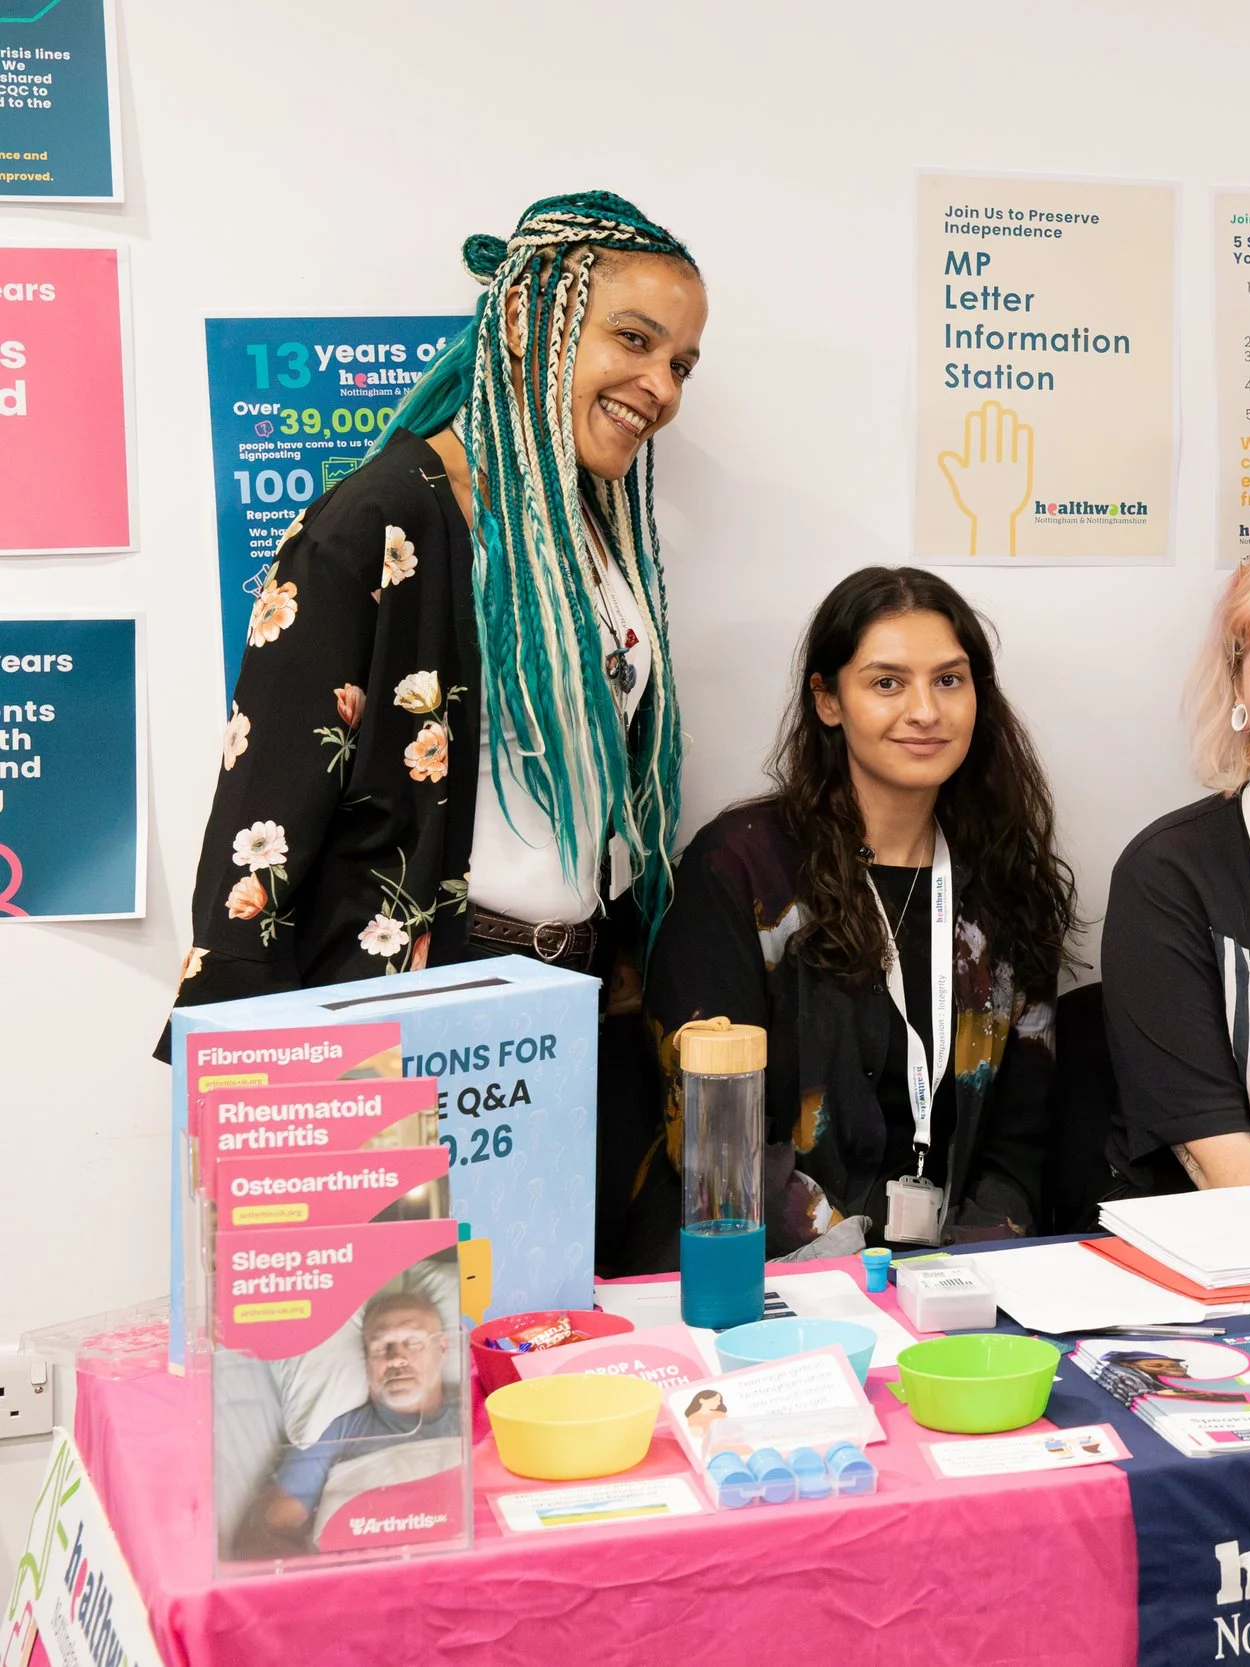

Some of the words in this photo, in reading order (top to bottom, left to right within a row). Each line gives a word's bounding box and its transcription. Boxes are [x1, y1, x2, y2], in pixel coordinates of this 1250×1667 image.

[35, 48, 71, 60] lines
[2, 60, 26, 71] We
[0, 72, 52, 84] shared
[33, 86, 48, 96] to
[8, 98, 24, 108] to
[27, 97, 52, 109] the
[23, 151, 48, 161] and
[944, 205, 980, 219] Join
[984, 207, 1004, 220] Us
[1008, 209, 1024, 221] to
[1029, 210, 1100, 224] Preserve
[944, 221, 1063, 239] Independence
[1233, 236, 1242, 248] 5
[944, 251, 991, 276] MP
[945, 284, 1035, 312] Letter
[945, 324, 1131, 354] Information
[247, 342, 312, 390] 13
[314, 343, 407, 371] years
[416, 337, 447, 362] of
[944, 362, 1054, 391] Station
[340, 388, 393, 398] Nottingham
[233, 401, 281, 416] Over
[280, 407, 395, 439] 39,000
[239, 441, 275, 452] people
[277, 441, 303, 449] have
[305, 440, 334, 449] come
[336, 439, 348, 448] to
[349, 440, 362, 448] us
[239, 450, 301, 461] signposting
[233, 468, 314, 504] 100
[246, 508, 296, 522] Reports
[1034, 500, 1148, 516] healthwatch
[1034, 516, 1078, 525] Nottingham
[1086, 516, 1147, 525] Nottinghamshire
[250, 538, 273, 548] and
[937, 974, 948, 1012] Integrity
[197, 1041, 343, 1066] Fibromyalgia
[499, 1034, 557, 1067] FOR
[936, 1019, 946, 1070] Compassion
[457, 1078, 532, 1118] Q&A
[218, 1095, 382, 1124] Rheumatoid
[218, 1125, 329, 1150] arthritis
[230, 1168, 399, 1197] Osteoarthritis
[231, 1248, 302, 1271] Sleep
[306, 1243, 353, 1266] and
[232, 1270, 334, 1296] arthritis
